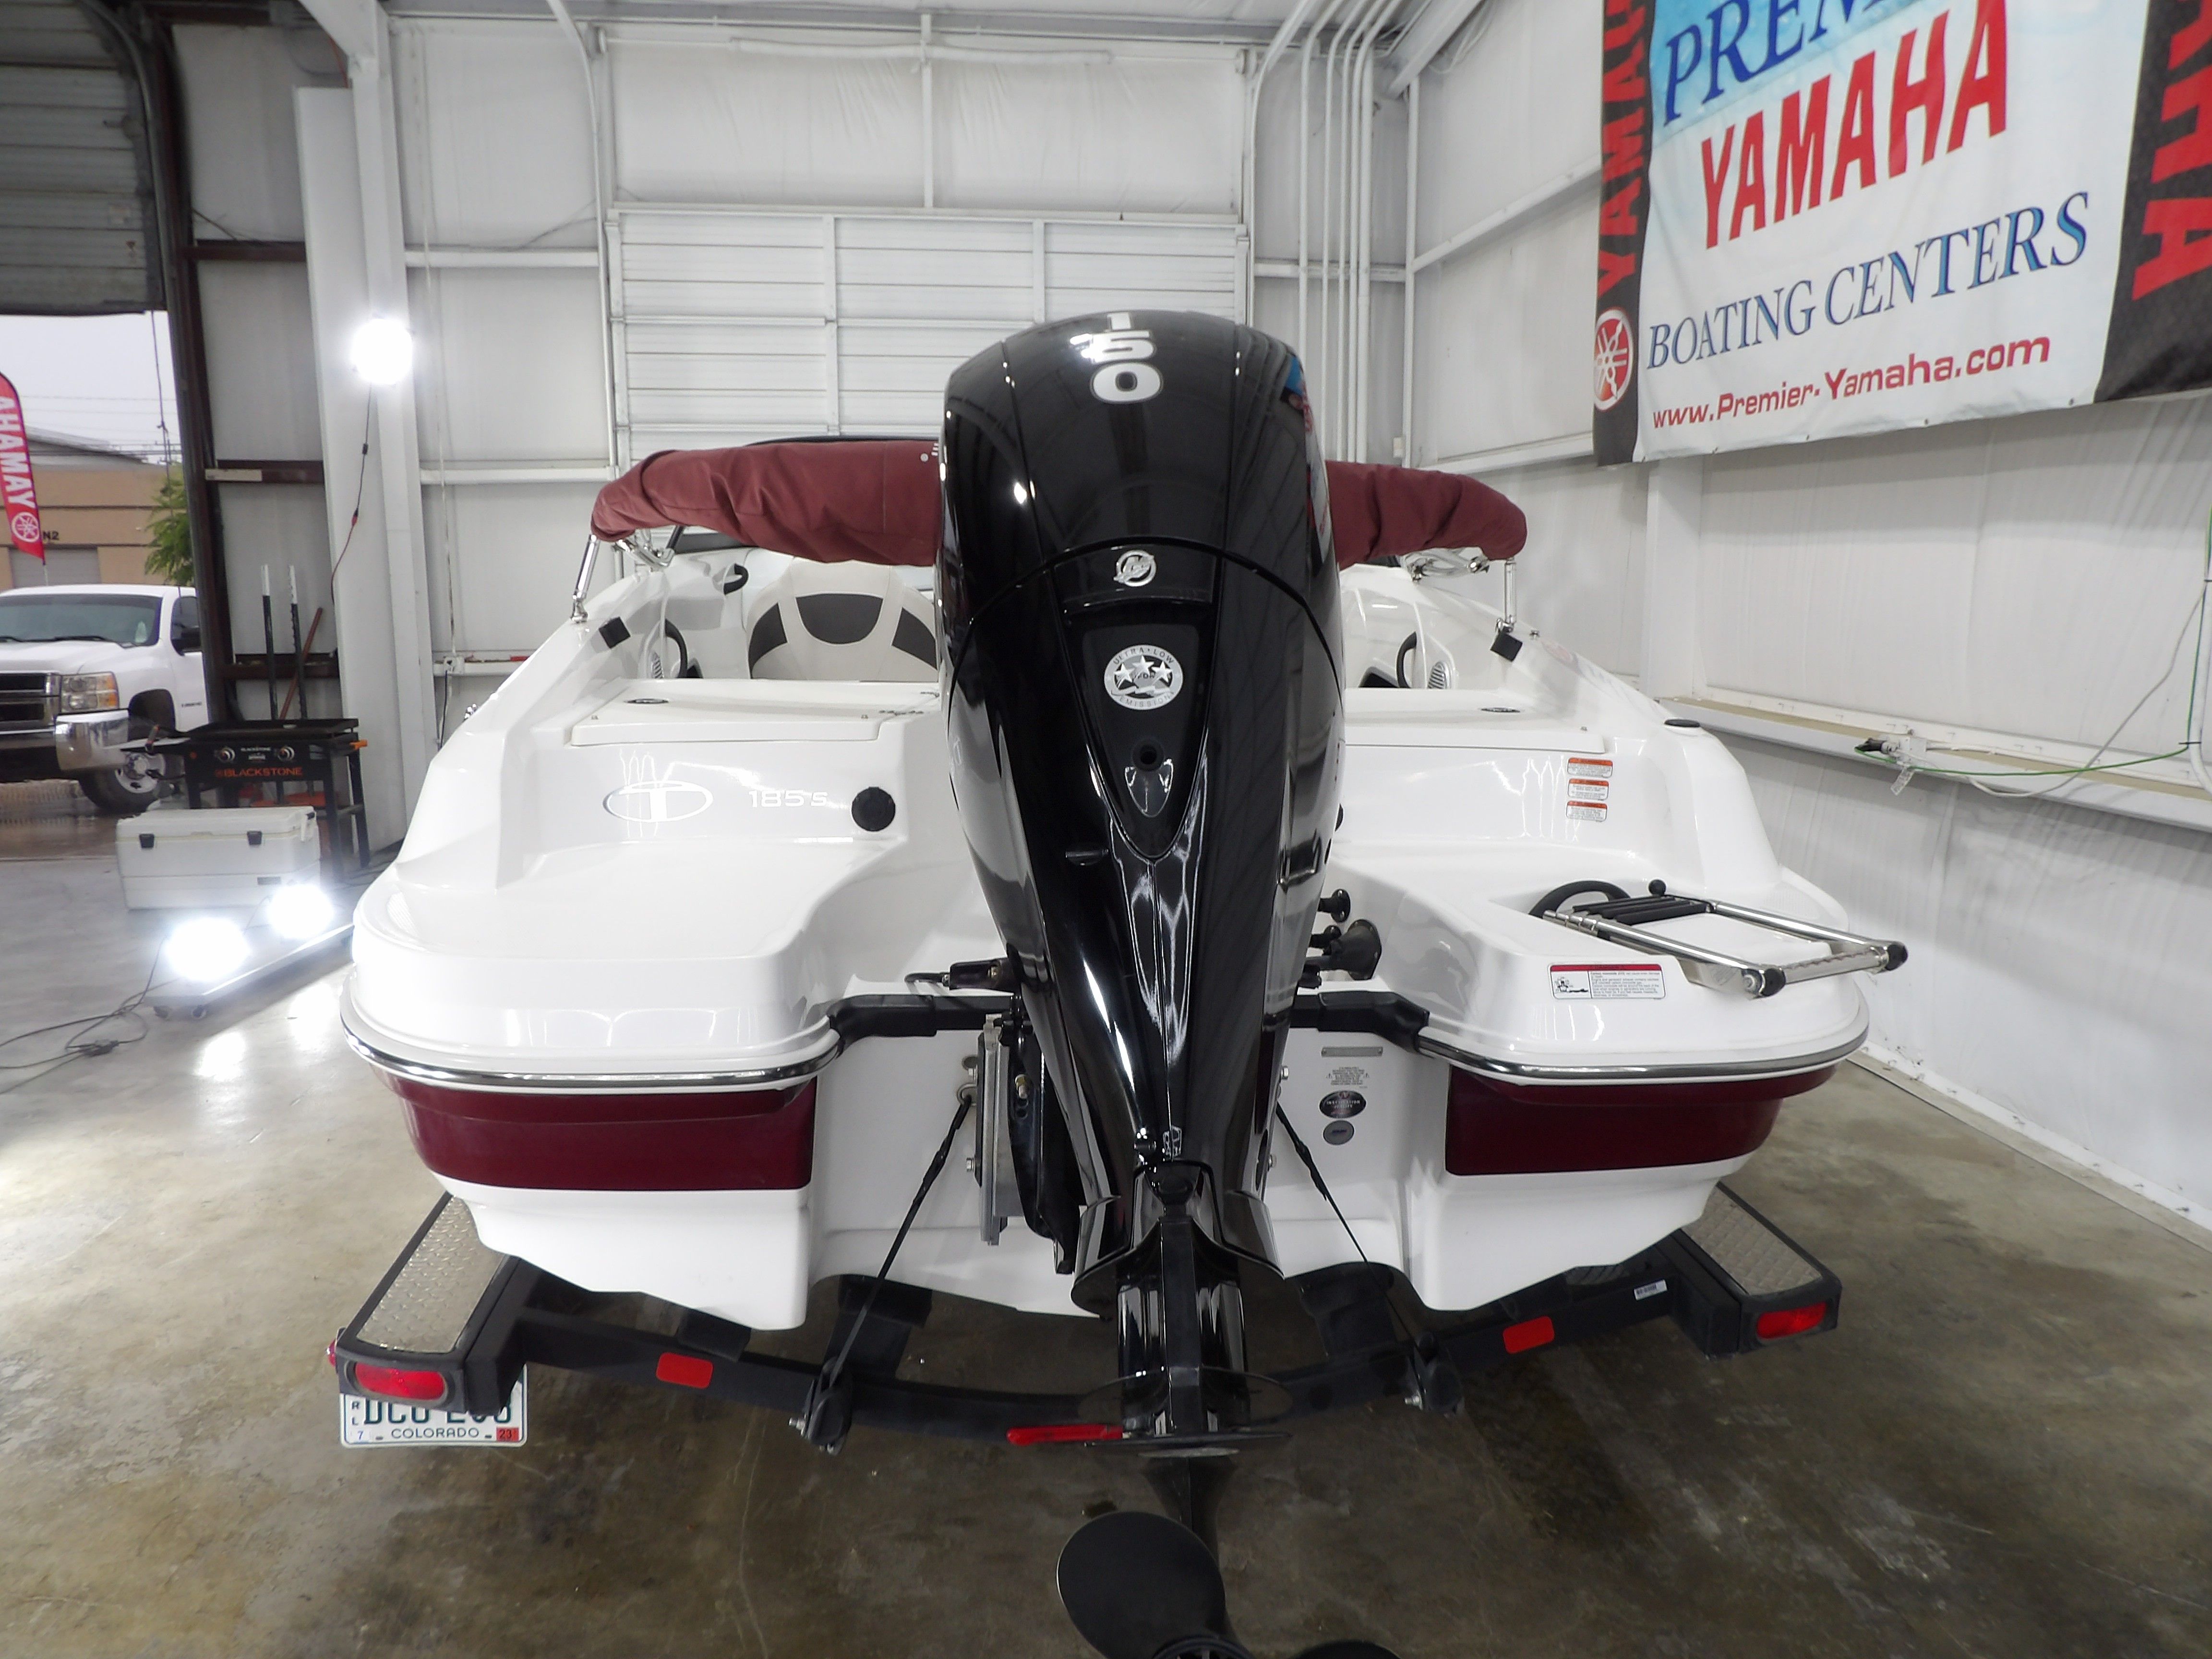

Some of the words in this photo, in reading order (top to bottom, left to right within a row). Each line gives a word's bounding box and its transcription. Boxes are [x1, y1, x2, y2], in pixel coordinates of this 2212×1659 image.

[1701, 0, 2008, 249] YAMAHA
[1647, 280, 1817, 370] BOATING
[1825, 192, 2089, 325] CENTERS
[1091, 312, 1161, 402] 150
[1113, 647, 1144, 665] ULTRA
[1154, 649, 1174, 664] LOW
[224, 768, 302, 777] BLACKSTONE
[391, 1427, 480, 1439] COLORADO
[498, 1429, 512, 1439] 23
